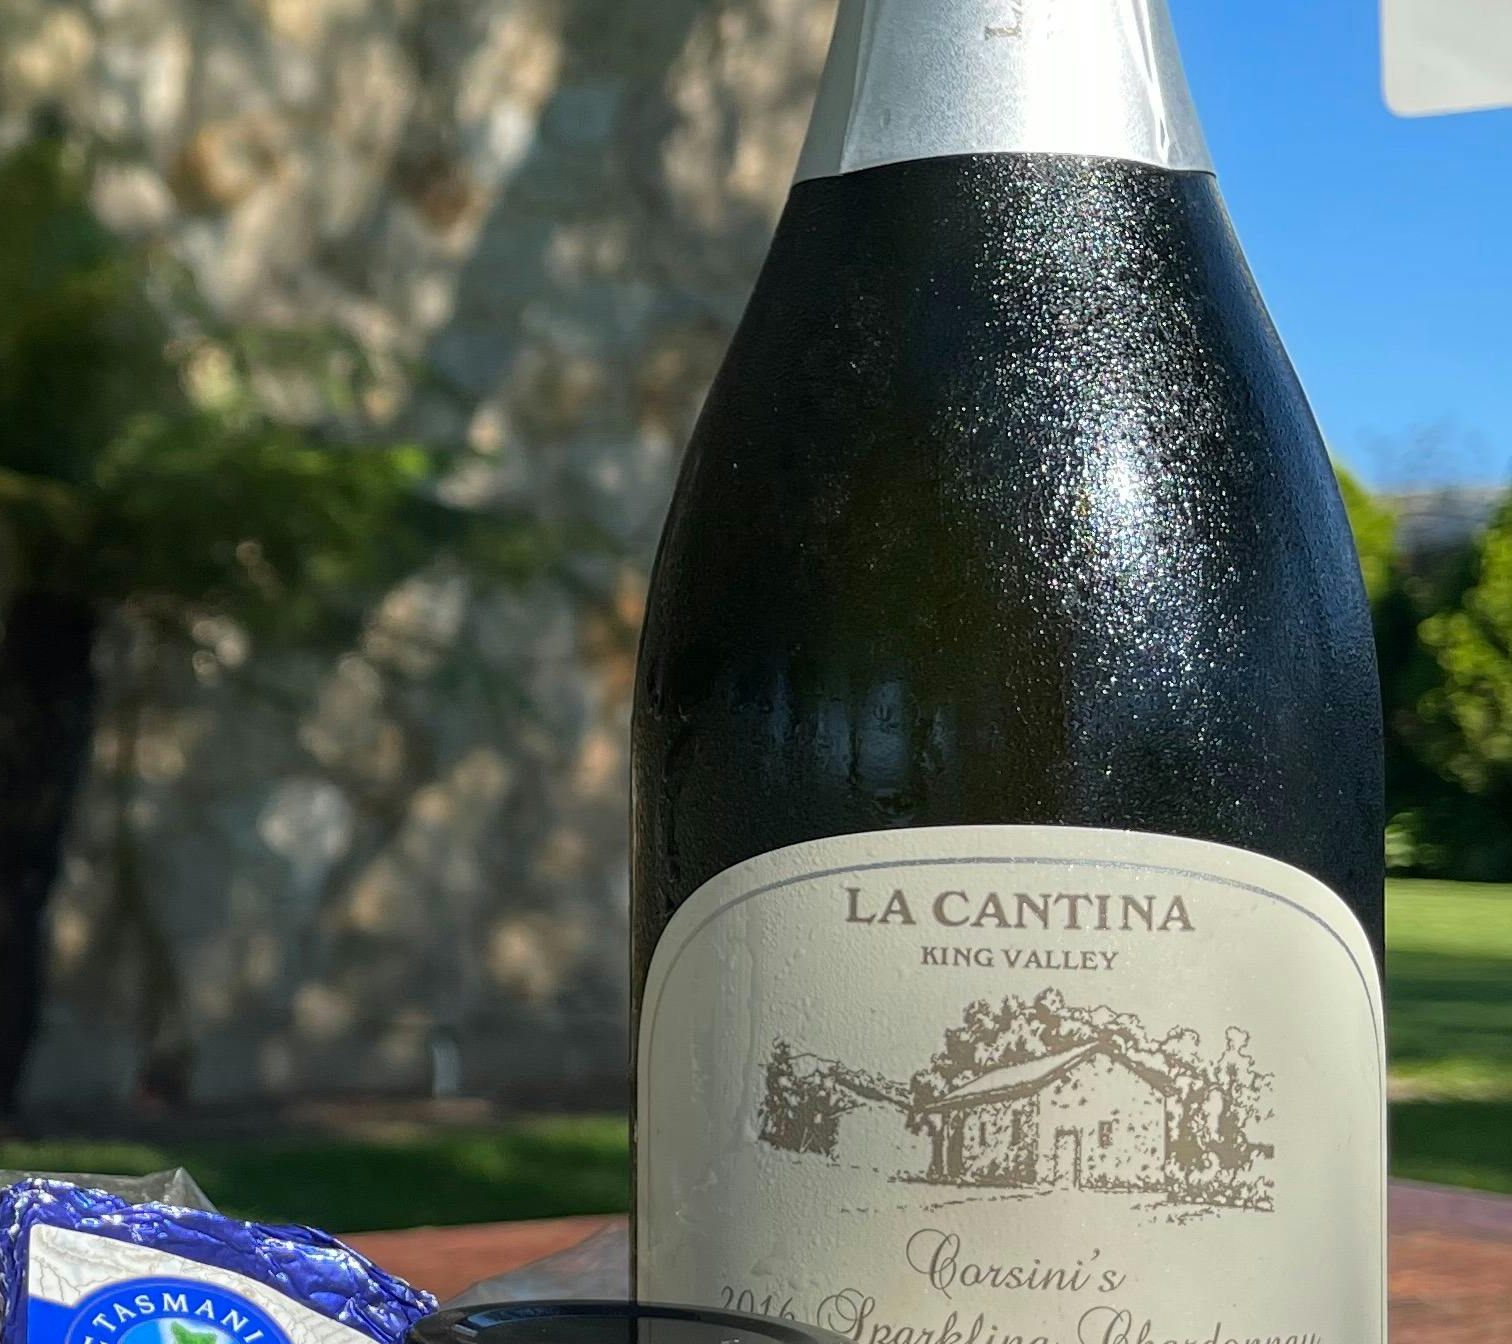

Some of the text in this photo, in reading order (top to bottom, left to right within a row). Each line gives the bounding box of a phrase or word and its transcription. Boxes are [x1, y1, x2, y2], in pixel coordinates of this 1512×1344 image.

[845, 887, 1196, 933] LA CANTINA
[920, 946, 1120, 972] KING VALLEY
[905, 1229, 1127, 1299] Corsini's
